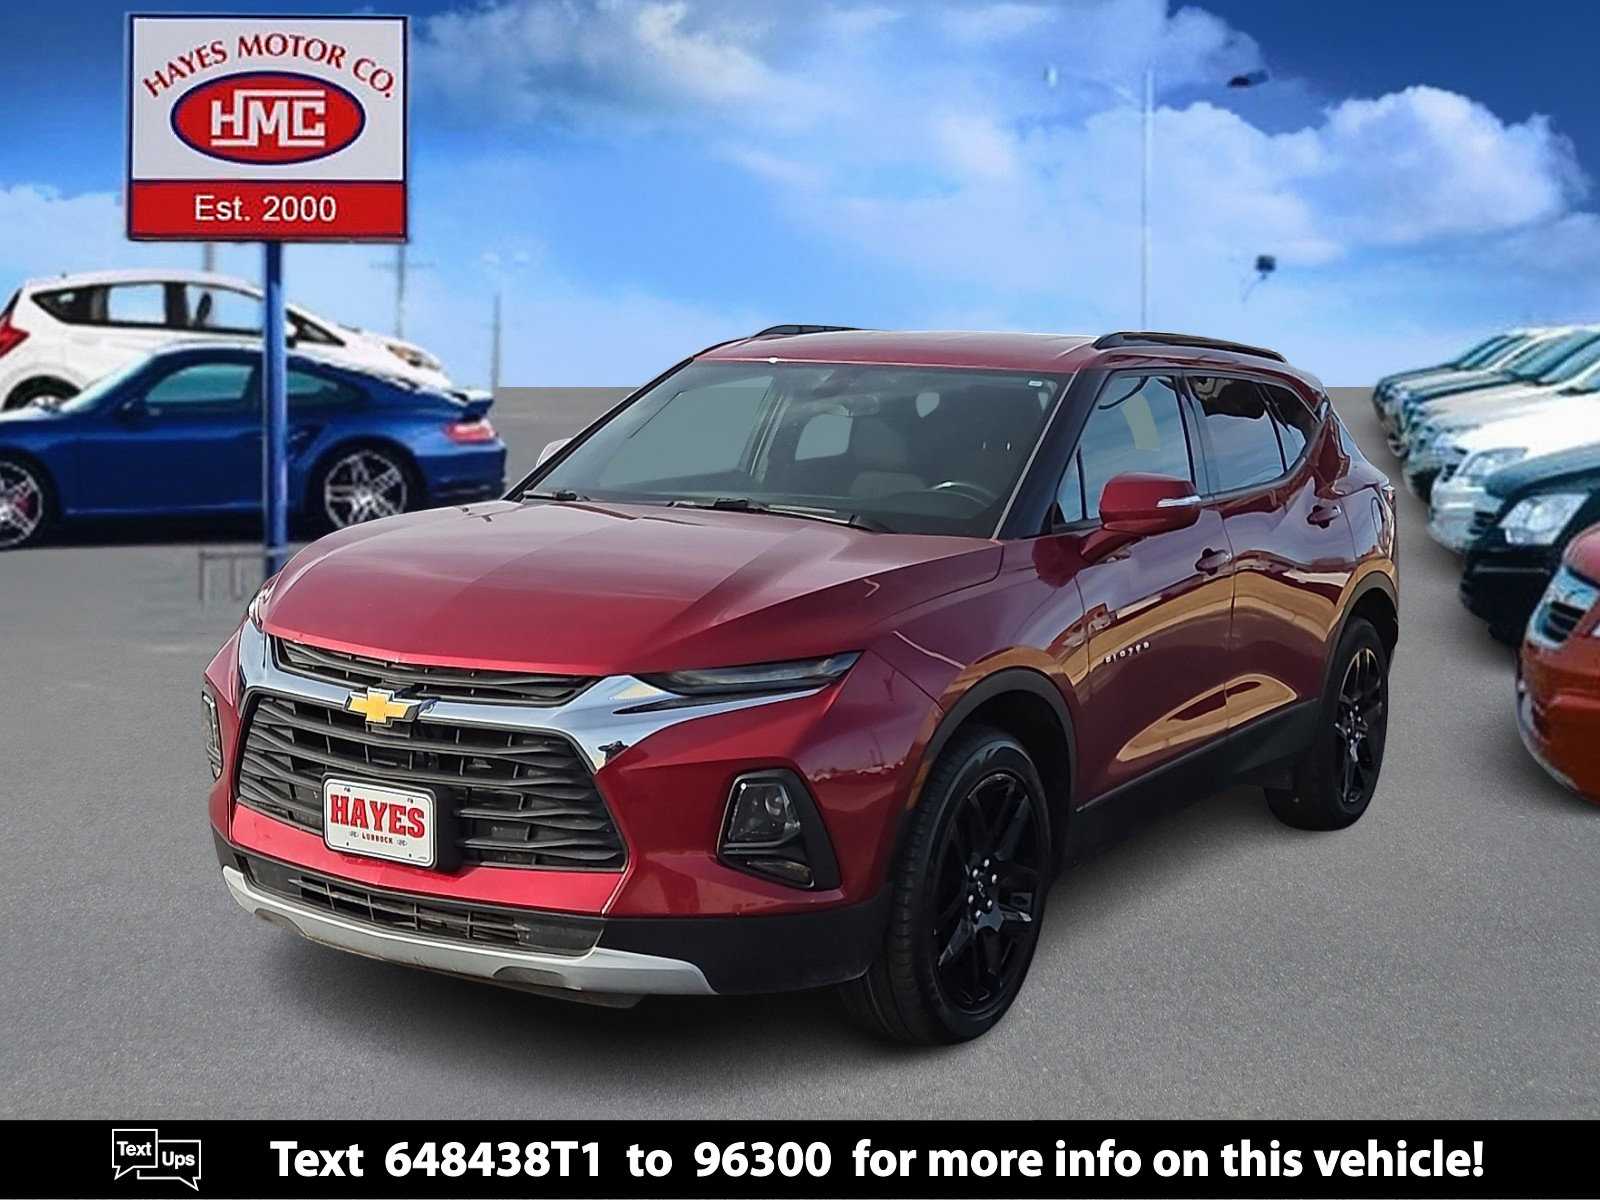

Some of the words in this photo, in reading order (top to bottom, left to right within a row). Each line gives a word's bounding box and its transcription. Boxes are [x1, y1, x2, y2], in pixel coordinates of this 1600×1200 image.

[142, 40, 227, 98] HAYES
[237, 32, 346, 70] MOTOR
[352, 57, 395, 99] CO.
[210, 89, 326, 147] HMC
[194, 195, 251, 222] Est.
[262, 195, 337, 222] 2000
[330, 794, 425, 838] HAYES
